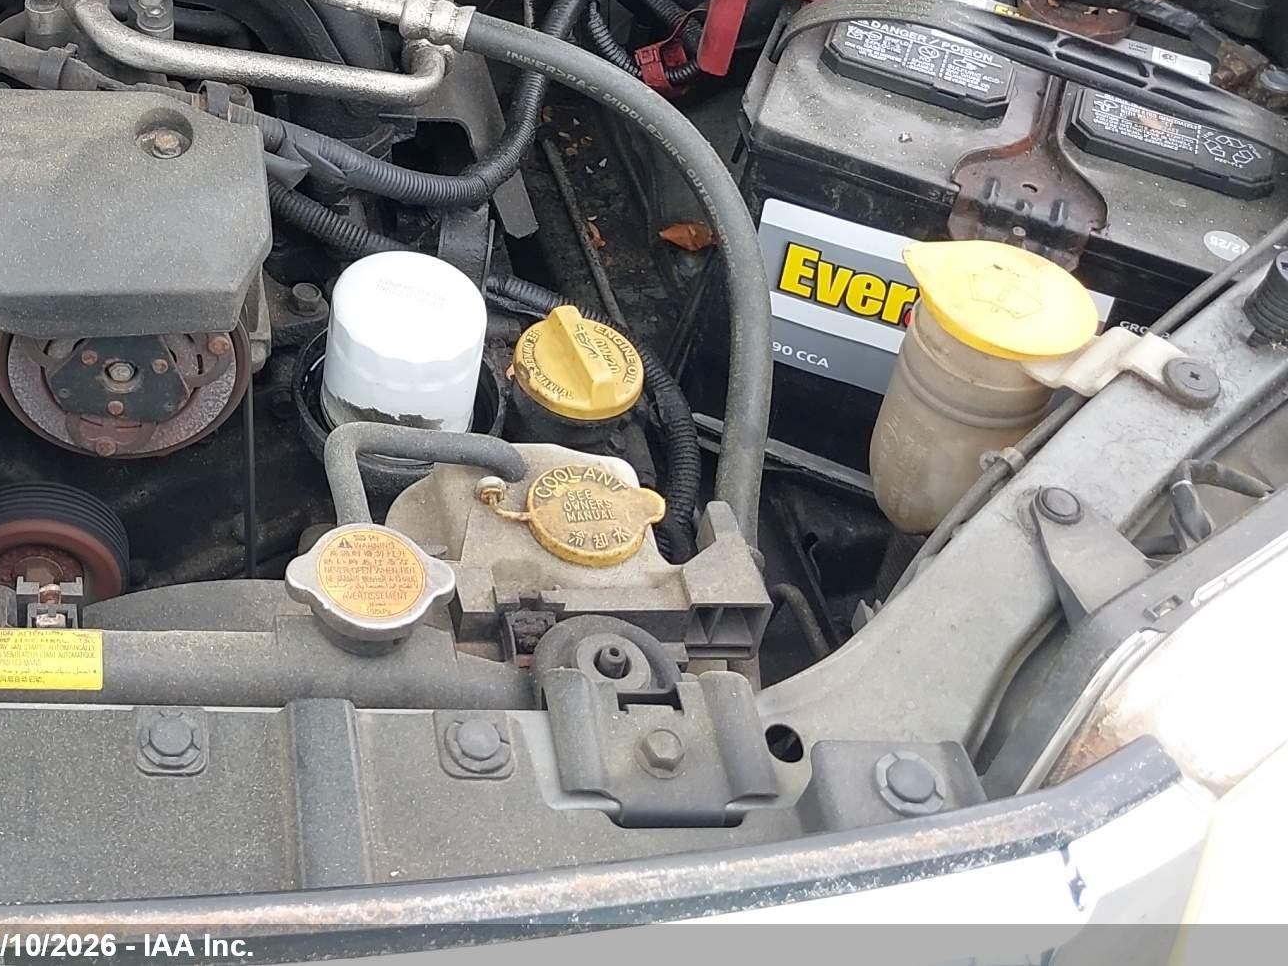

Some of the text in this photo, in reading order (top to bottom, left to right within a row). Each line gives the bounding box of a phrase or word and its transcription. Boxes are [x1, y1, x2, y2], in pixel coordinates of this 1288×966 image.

[870, 19, 993, 62] DANGER / POISON
[779, 242, 919, 325] Ever
[1119, 320, 1149, 335] GRO
[594, 325, 637, 384] ENGINE OIL
[771, 341, 829, 368] 90 CCA
[535, 466, 627, 498] COOLANT
[563, 498, 613, 512] OWNERS
[567, 489, 593, 501] SEE
[566, 509, 615, 523] MANUAL
[568, 527, 630, 549] 冷却水
